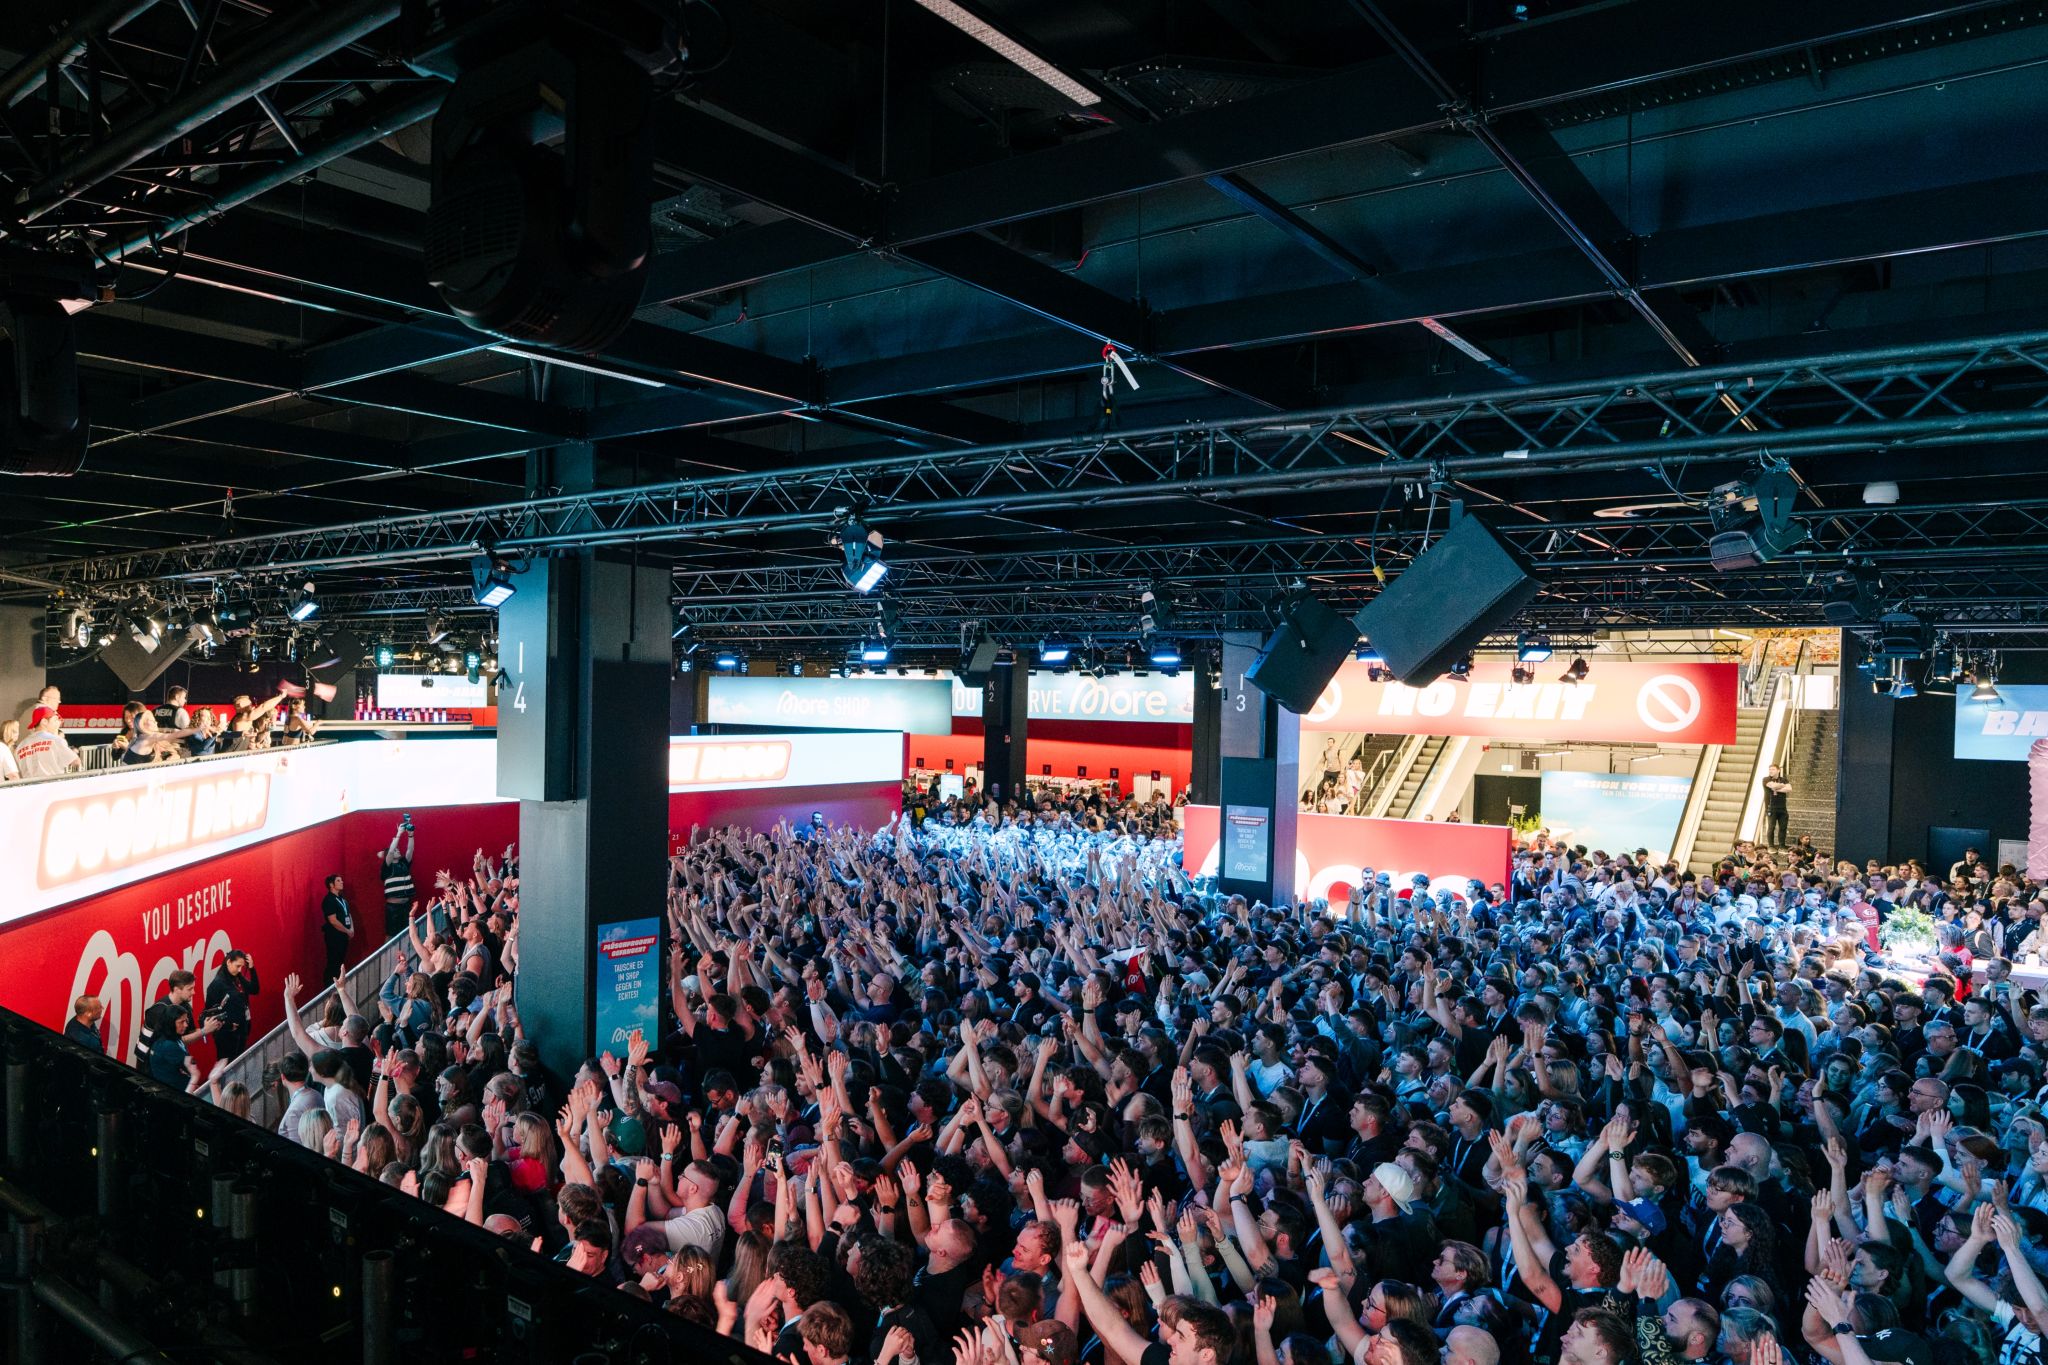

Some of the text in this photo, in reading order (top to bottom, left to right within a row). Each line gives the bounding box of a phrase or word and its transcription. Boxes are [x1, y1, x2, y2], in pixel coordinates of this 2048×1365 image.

[513, 681, 527, 714] 4
[776, 690, 829, 714] More
[953, 688, 976, 711] OU
[1068, 677, 1168, 716] More
[988, 692, 995, 702] 2
[1235, 694, 1246, 712] 3
[1380, 683, 1597, 720] NO EXIT
[143, 879, 231, 943] YOU DESERVE
[614, 960, 644, 973] TAUSCHE ES
[617, 971, 640, 982] IM SHOP
[615, 982, 632, 992] GEGEN
